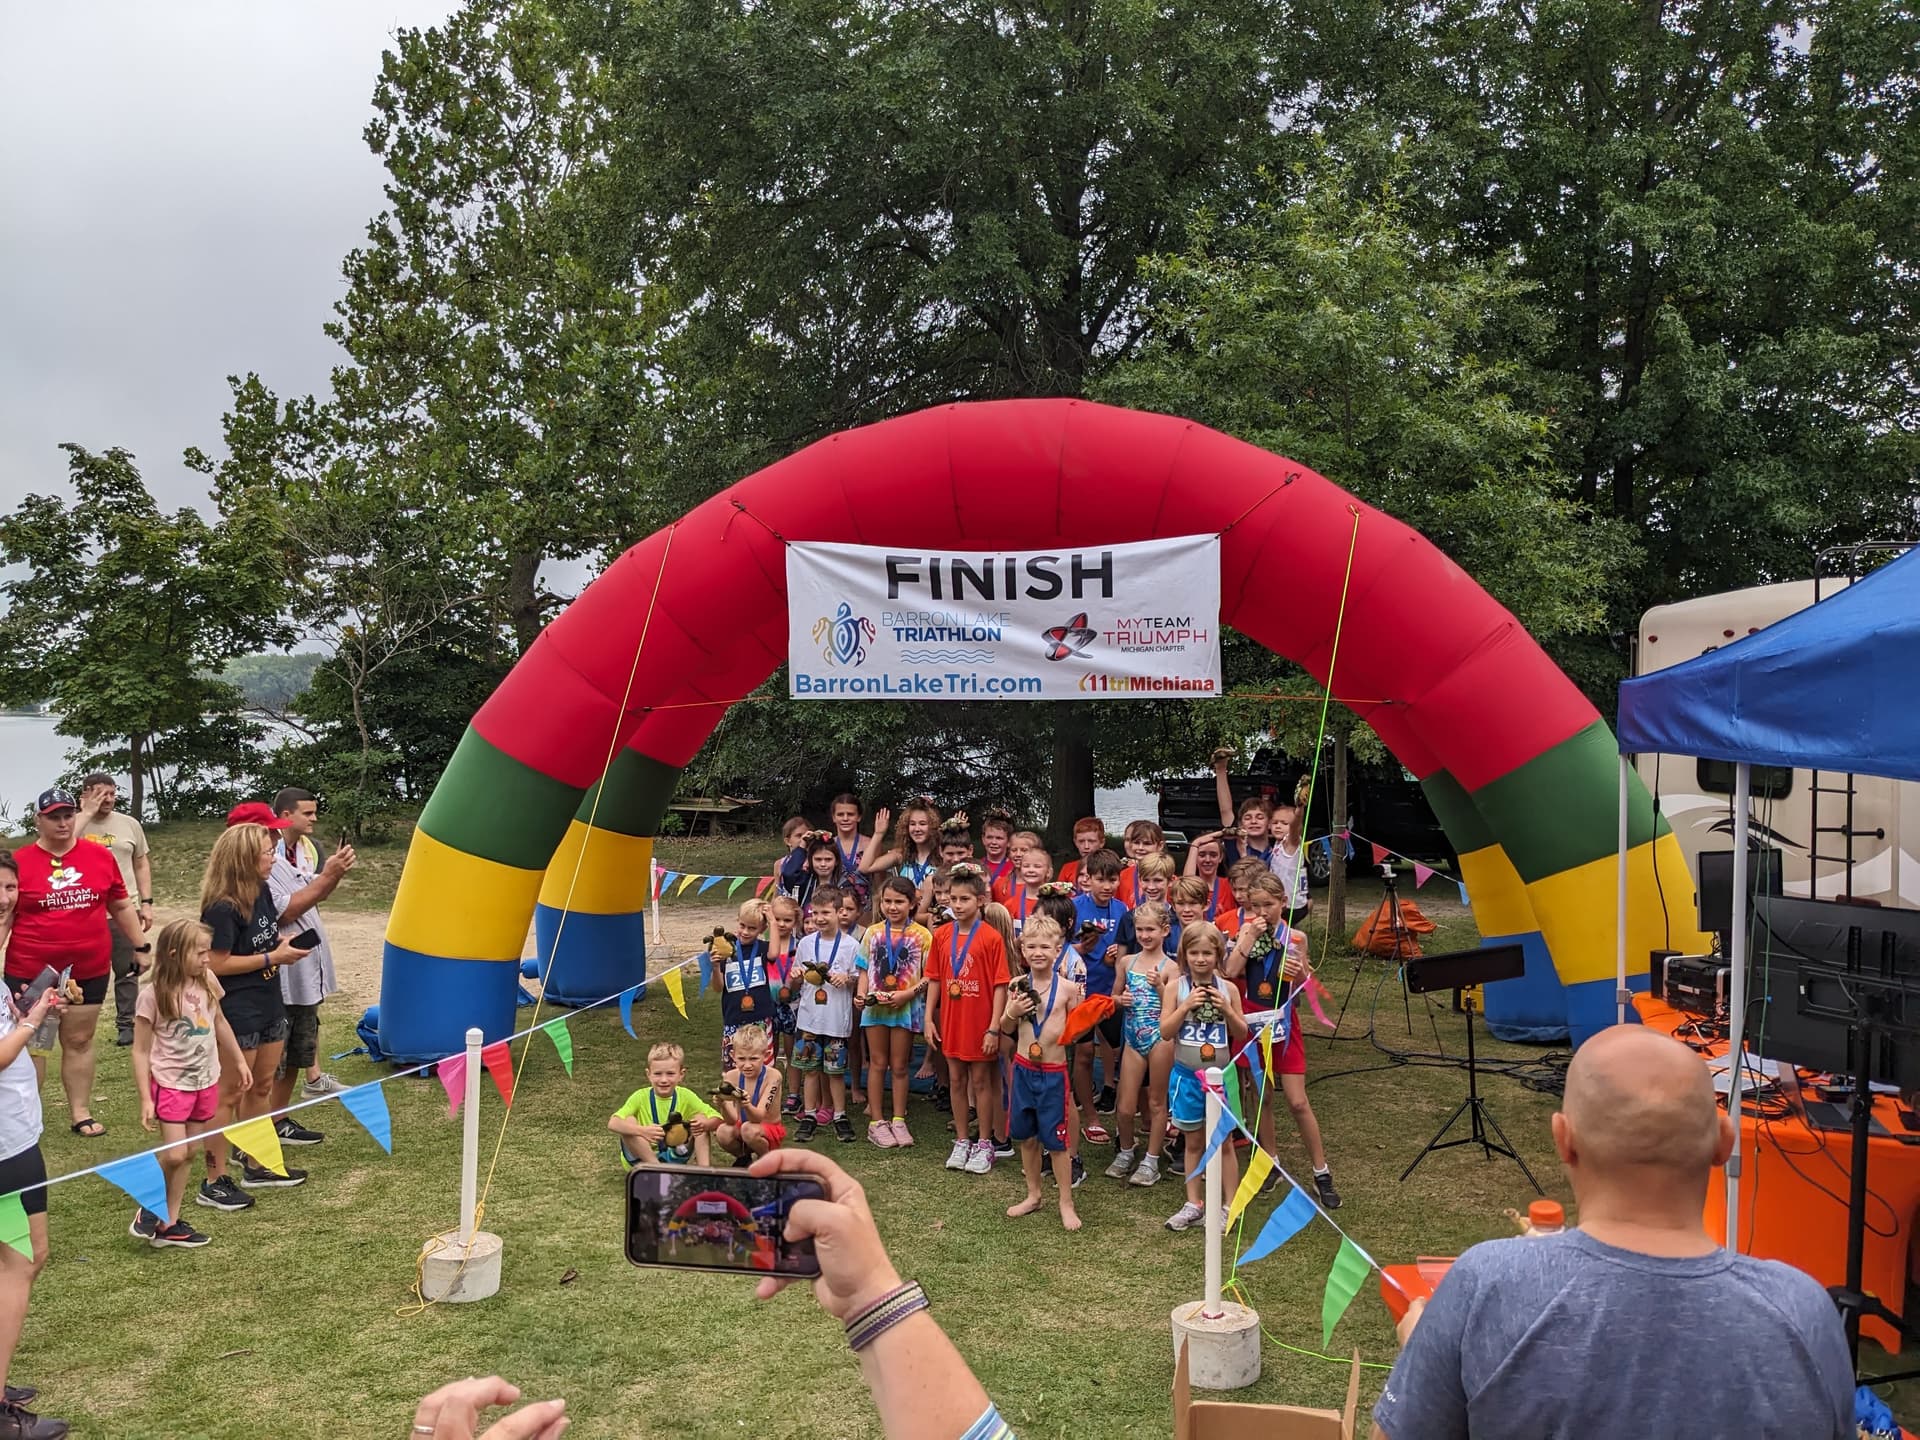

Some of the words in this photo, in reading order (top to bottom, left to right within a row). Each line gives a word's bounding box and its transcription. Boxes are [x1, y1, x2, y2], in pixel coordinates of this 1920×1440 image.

[886, 551, 1113, 600] FINISH
[882, 611, 957, 627] BARRON
[965, 612, 1011, 627] LAKE
[1117, 616, 1190, 629] MYTEAM
[893, 627, 1001, 642] TRIATHLON
[1103, 629, 1207, 645] TRIUMPH
[1155, 645, 1185, 653] CHAPTER
[796, 673, 1041, 694] BarronLakeTri.com
[38, 893, 99, 908] TRIUMPH
[46, 888, 91, 899] MYTEAM
[258, 915, 269, 928] GO
[1183, 1025, 1221, 1043] 264
